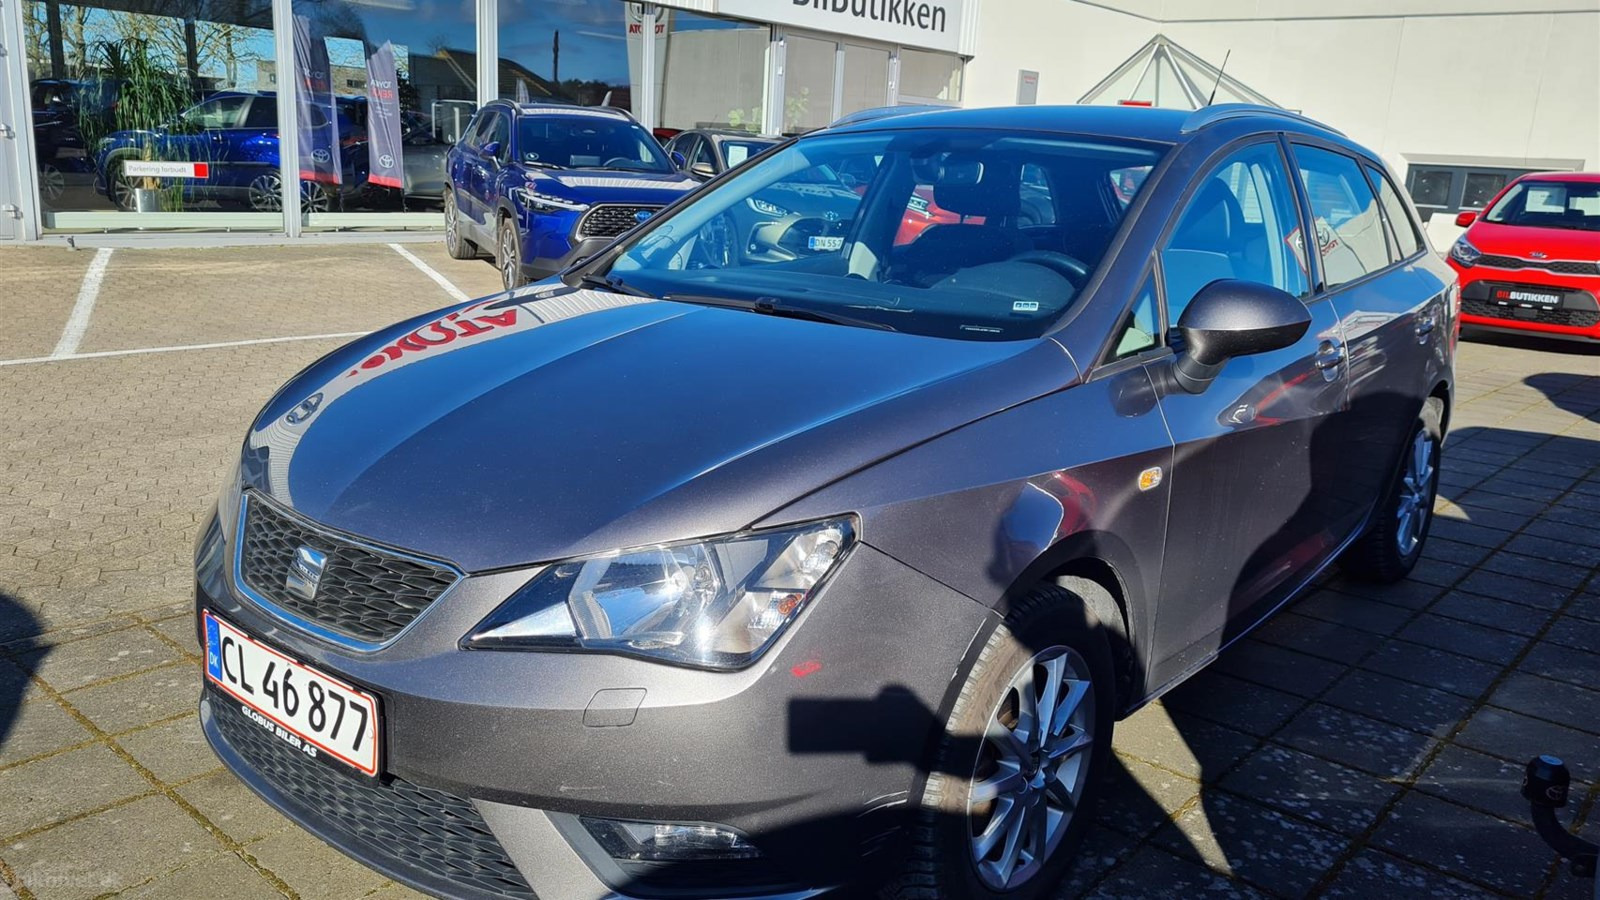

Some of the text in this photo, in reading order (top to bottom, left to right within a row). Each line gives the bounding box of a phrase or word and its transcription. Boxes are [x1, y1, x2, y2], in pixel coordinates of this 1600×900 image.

[792, 0, 946, 33] utikken
[1496, 290, 1559, 304] BILBUTIKKEN
[209, 651, 219, 668] DK
[221, 636, 369, 752] CL 46 877
[241, 705, 318, 758] GLOBUS BILER AS
